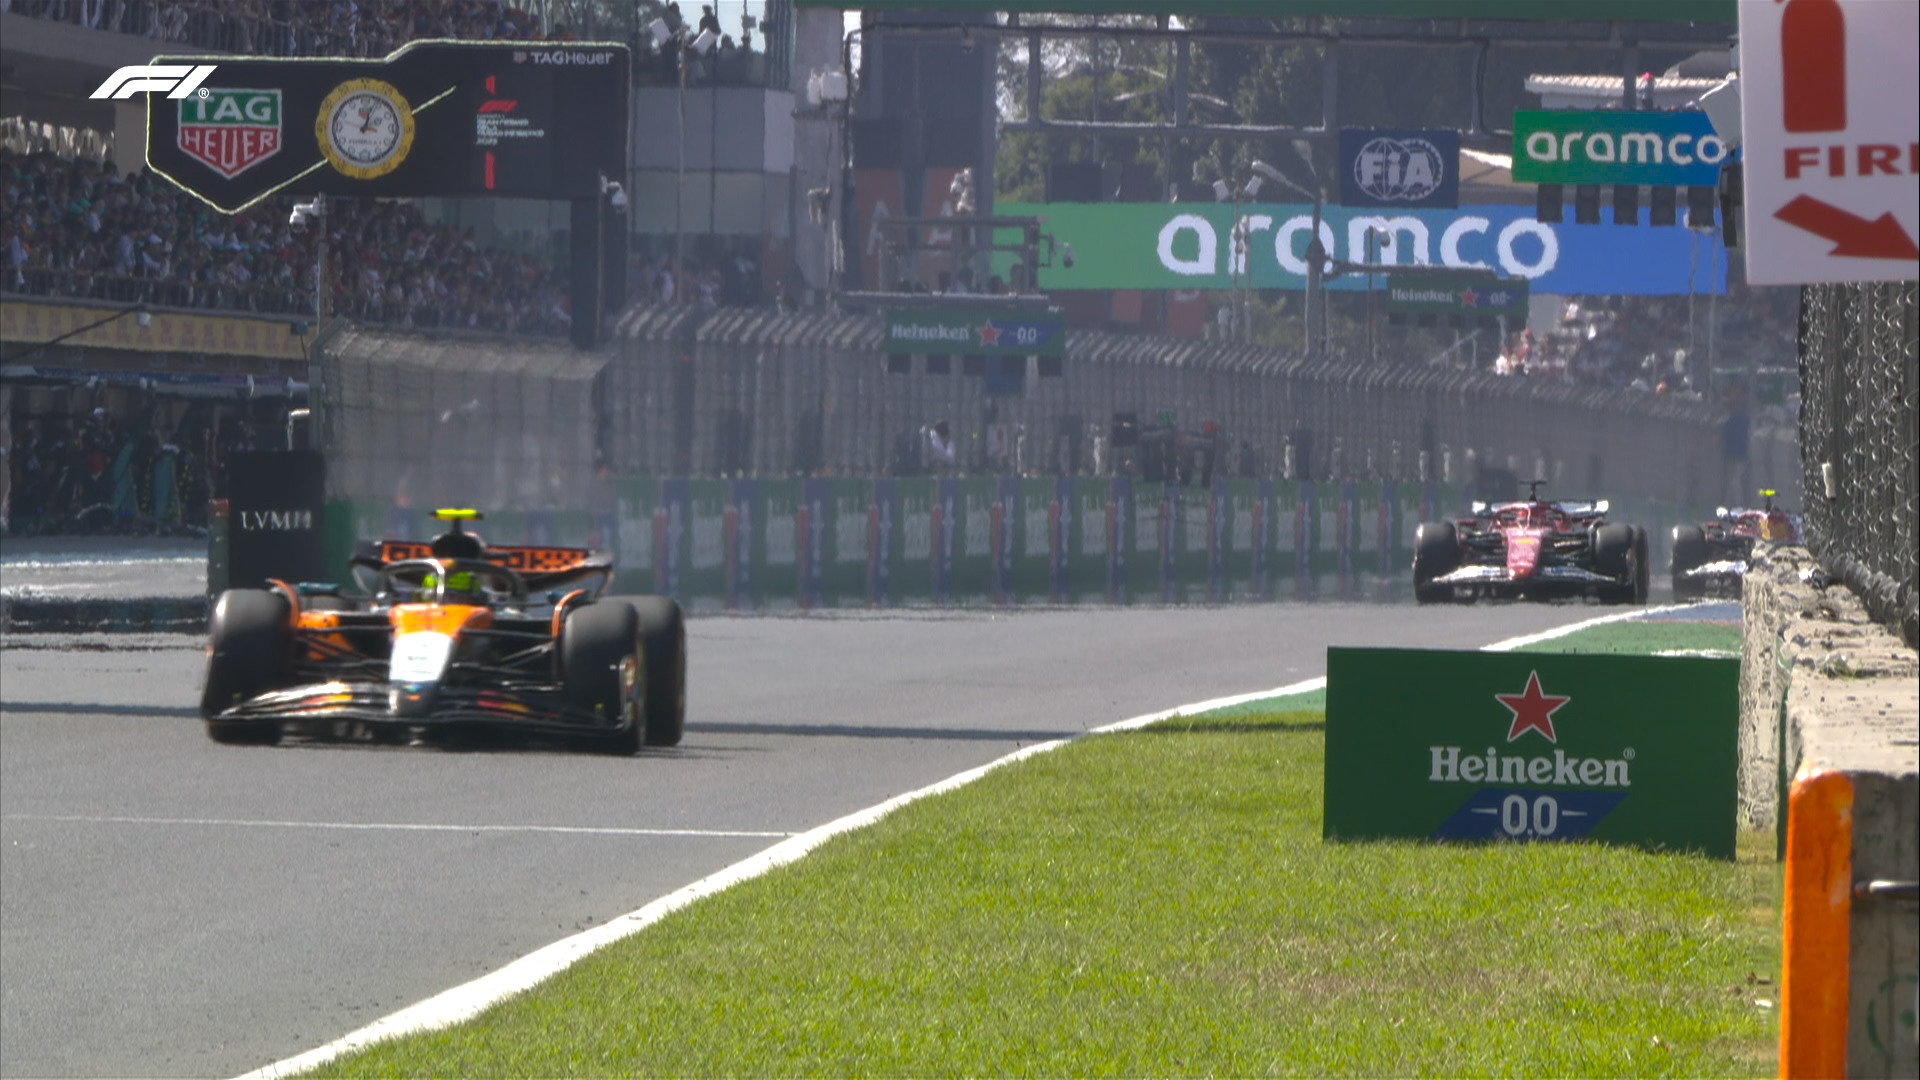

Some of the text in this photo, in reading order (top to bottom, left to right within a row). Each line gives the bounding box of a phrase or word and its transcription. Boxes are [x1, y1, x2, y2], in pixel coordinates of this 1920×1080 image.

[187, 96, 272, 121] TAG
[184, 129, 274, 169] HEUER
[1526, 131, 1728, 165] aramco
[1784, 143, 1920, 179] FIR
[1392, 288, 1454, 304] Heineken
[891, 323, 969, 341] Heineken
[241, 510, 312, 530] LVMH
[1429, 746, 1631, 787] Heineken
[1502, 794, 1558, 836] 0.0
